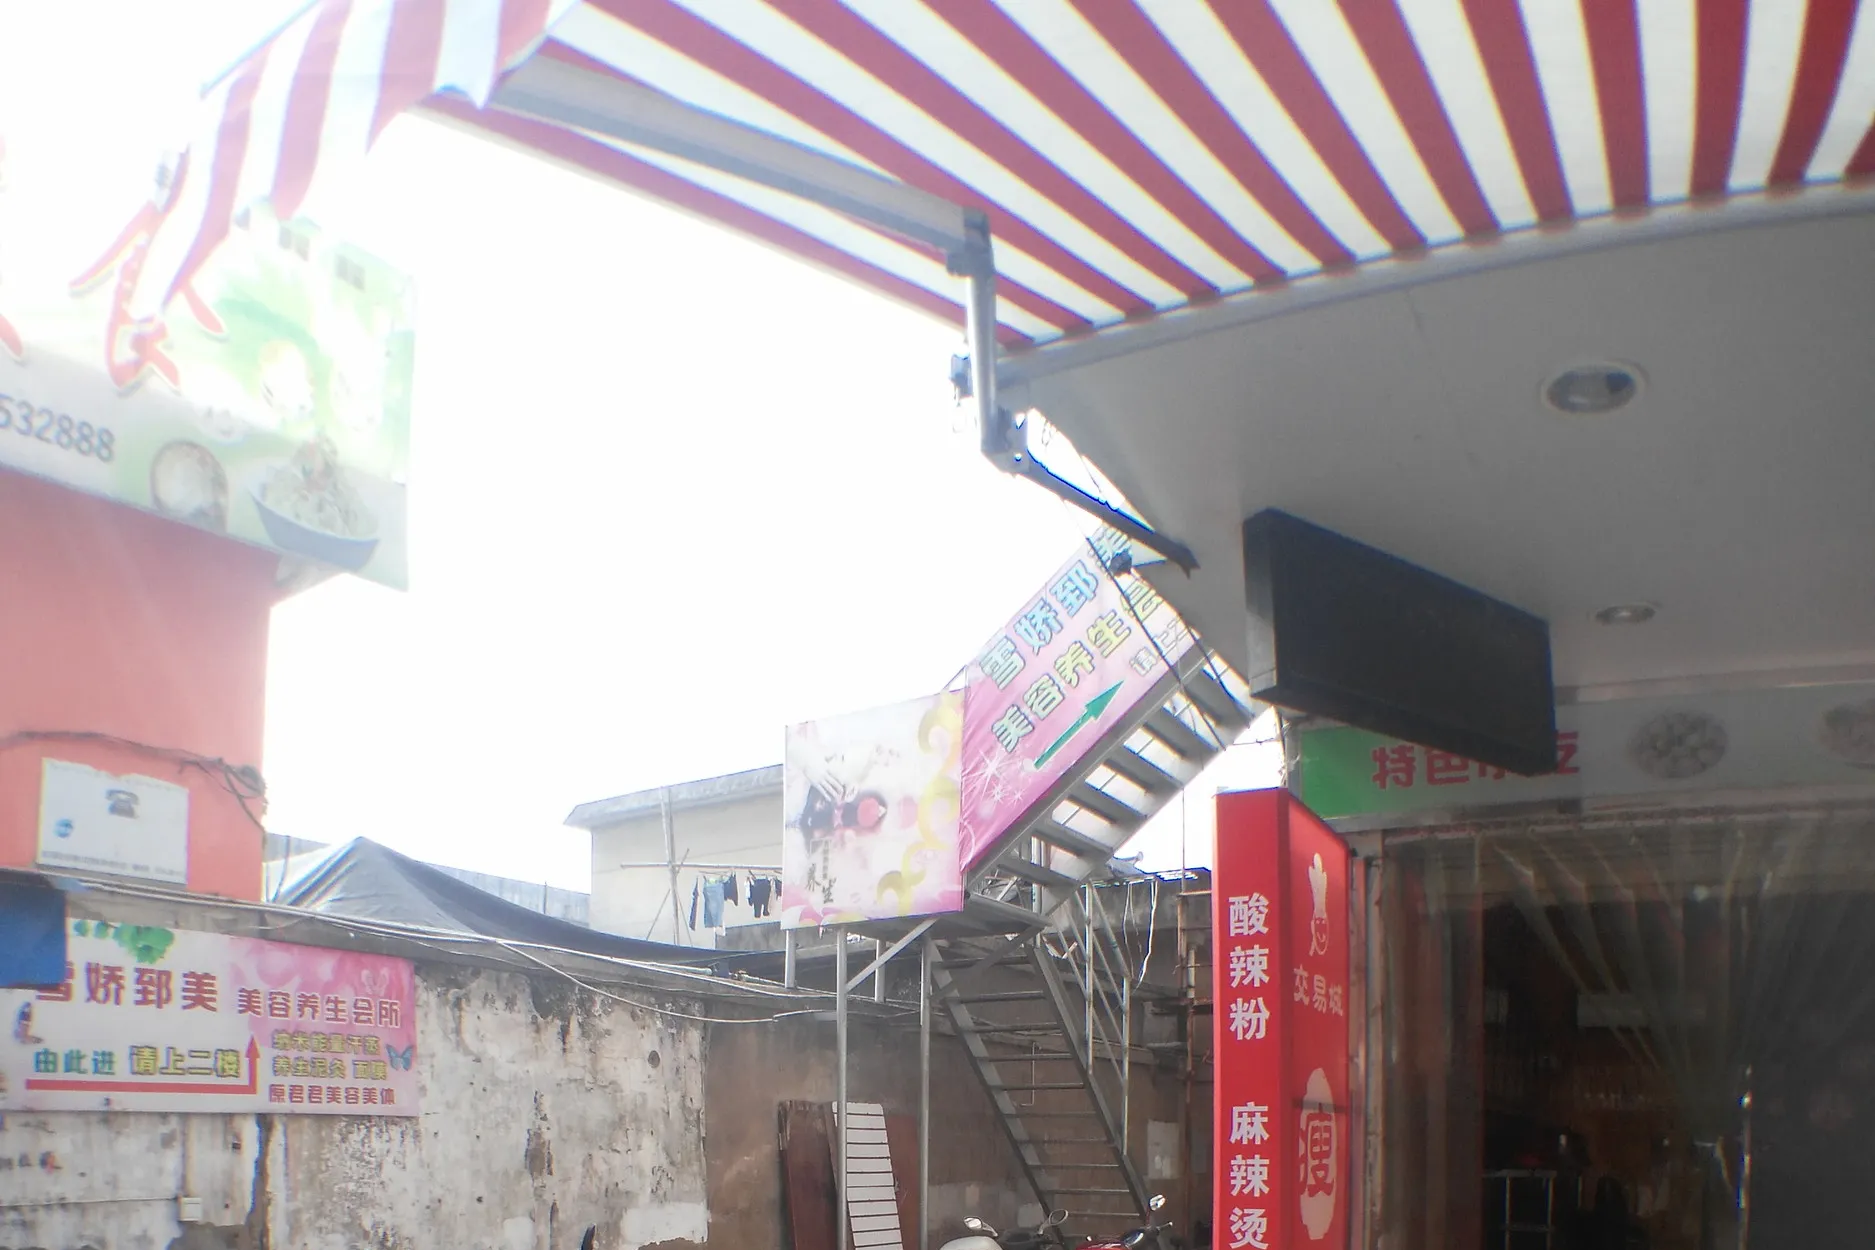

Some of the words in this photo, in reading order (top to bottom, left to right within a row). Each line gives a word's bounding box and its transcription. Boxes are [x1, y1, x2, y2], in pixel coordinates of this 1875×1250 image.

[0, 393, 115, 463] 532888
[1371, 731, 1580, 790] 特色
[1228, 892, 1271, 1042] 酸辣粉
[237, 987, 400, 1028] 美容养生会所
[33, 1048, 116, 1077] 由此进
[129, 1044, 241, 1079] 请上二楼
[268, 1083, 397, 1106] 原君君美容美体
[1228, 1101, 1270, 1250] 麻辣烫
